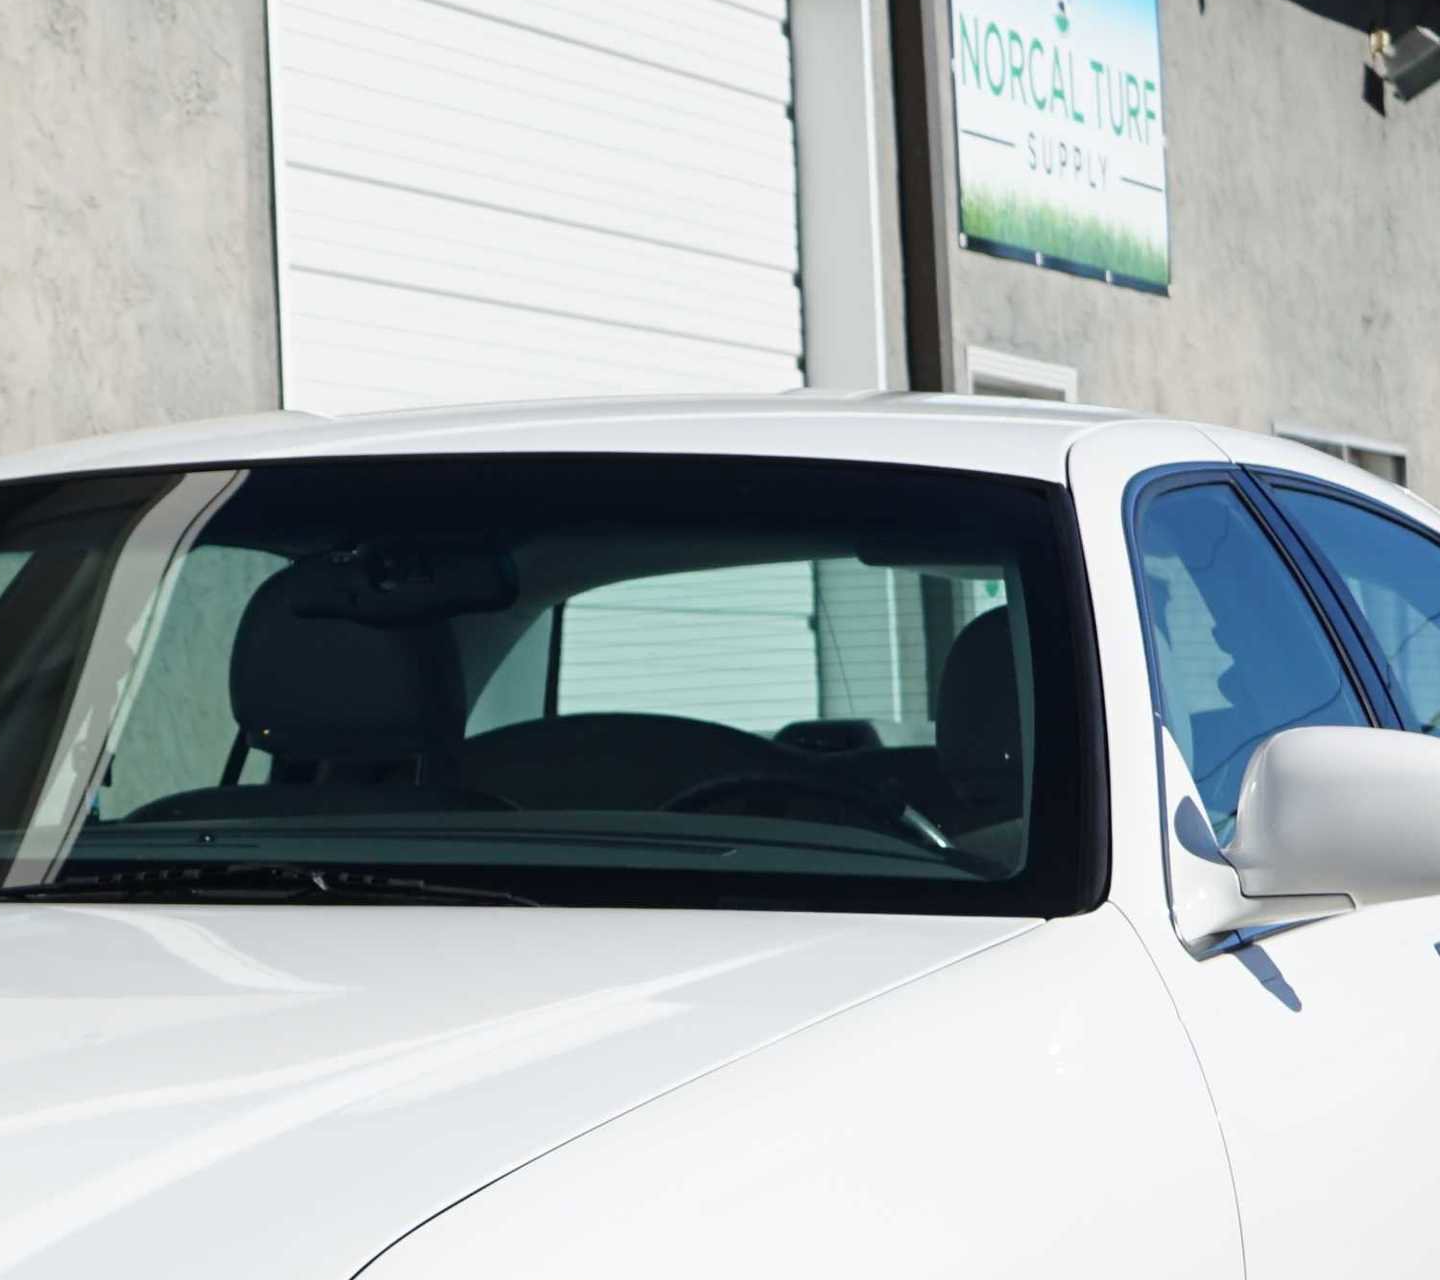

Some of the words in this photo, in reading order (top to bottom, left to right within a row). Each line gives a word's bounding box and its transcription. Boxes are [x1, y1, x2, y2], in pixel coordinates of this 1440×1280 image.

[959, 11, 1085, 125] NORCAL
[1089, 58, 1157, 146] TURF
[1027, 131, 1110, 190] SUPPLY
